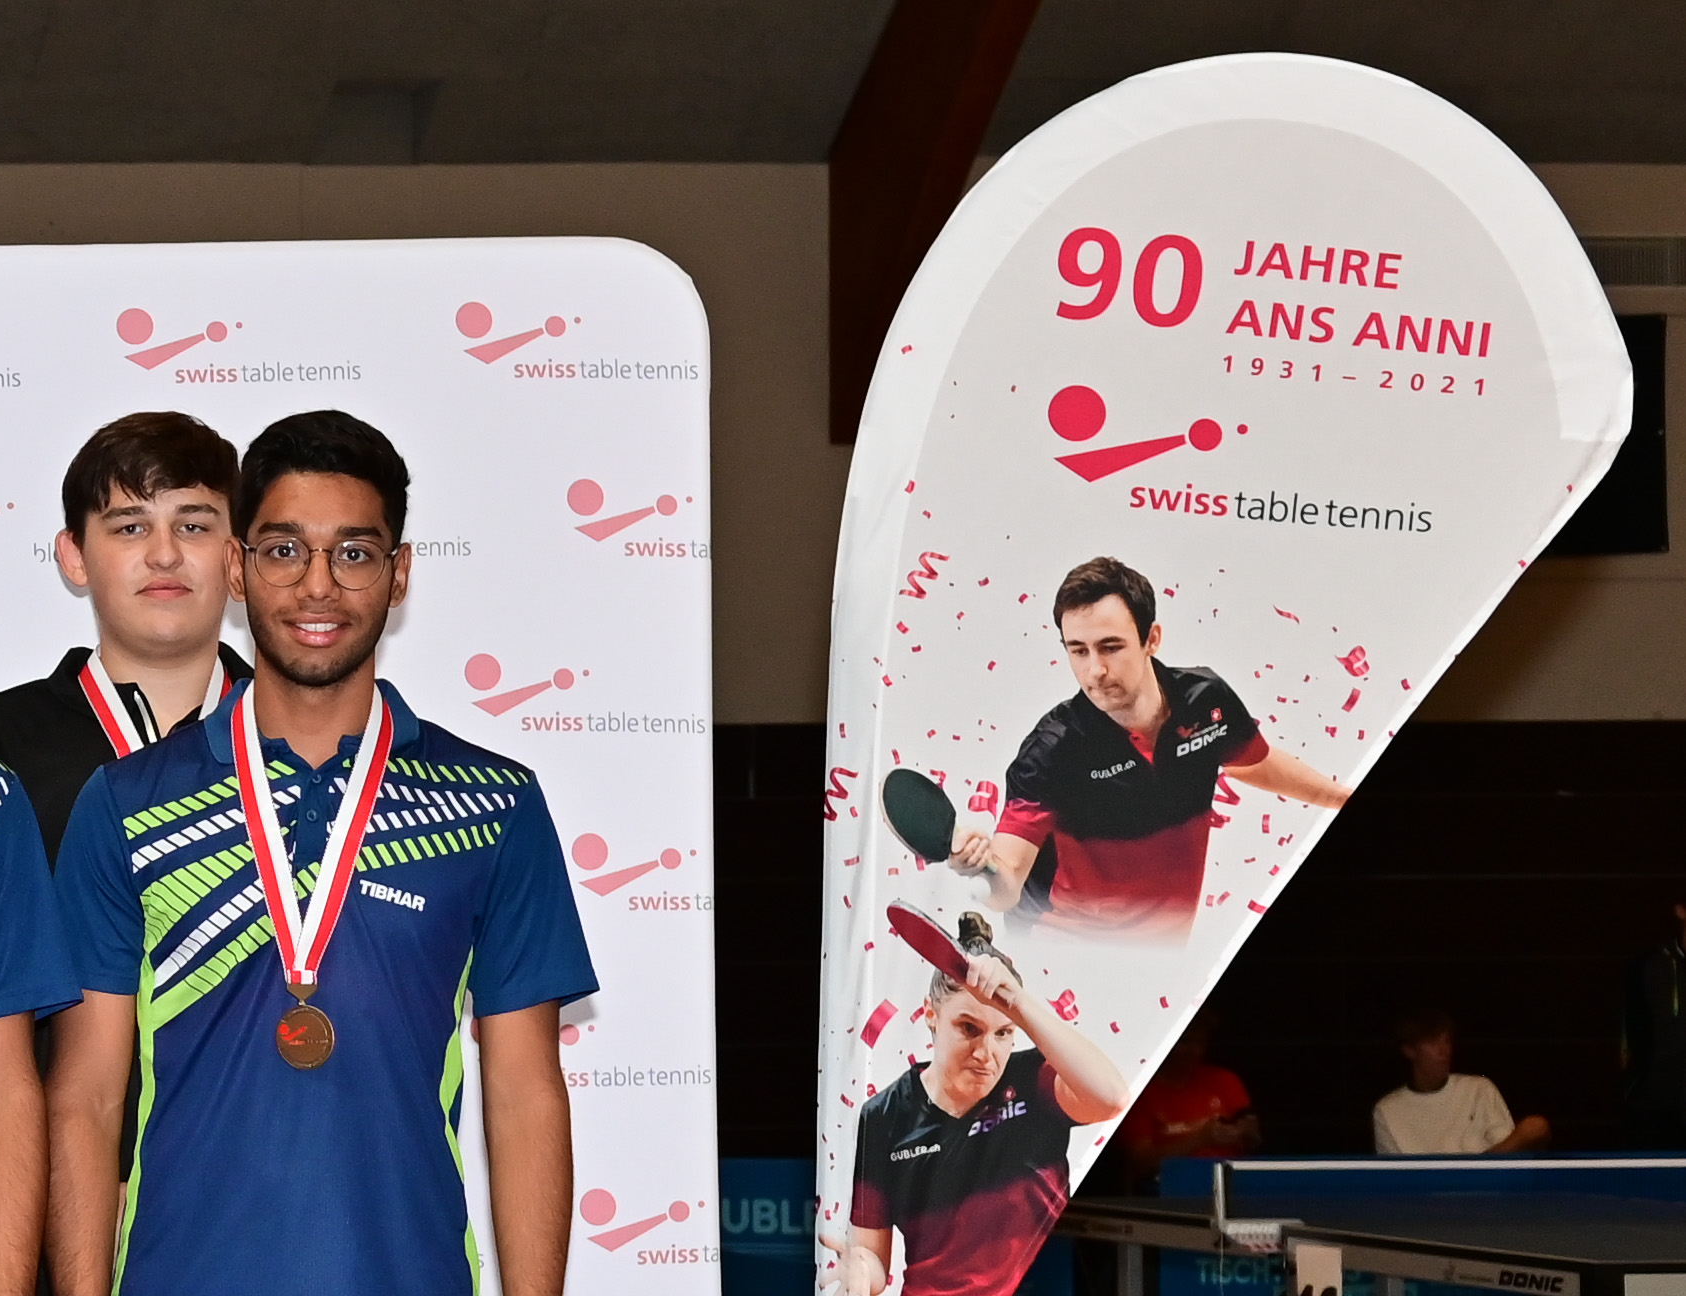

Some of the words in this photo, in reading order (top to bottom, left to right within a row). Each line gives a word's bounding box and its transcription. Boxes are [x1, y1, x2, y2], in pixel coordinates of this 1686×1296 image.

[1056, 227, 1203, 328] 90
[1234, 240, 1404, 291] JAHRE
[1226, 300, 1335, 345] ANS
[1353, 314, 1492, 358] ANNI
[1130, 483, 1228, 518] swiss
[1234, 491, 1319, 528] table
[1325, 499, 1432, 534] tennis
[359, 879, 425, 912] TIBHAR
[1499, 1270, 1565, 1293] DONIC
